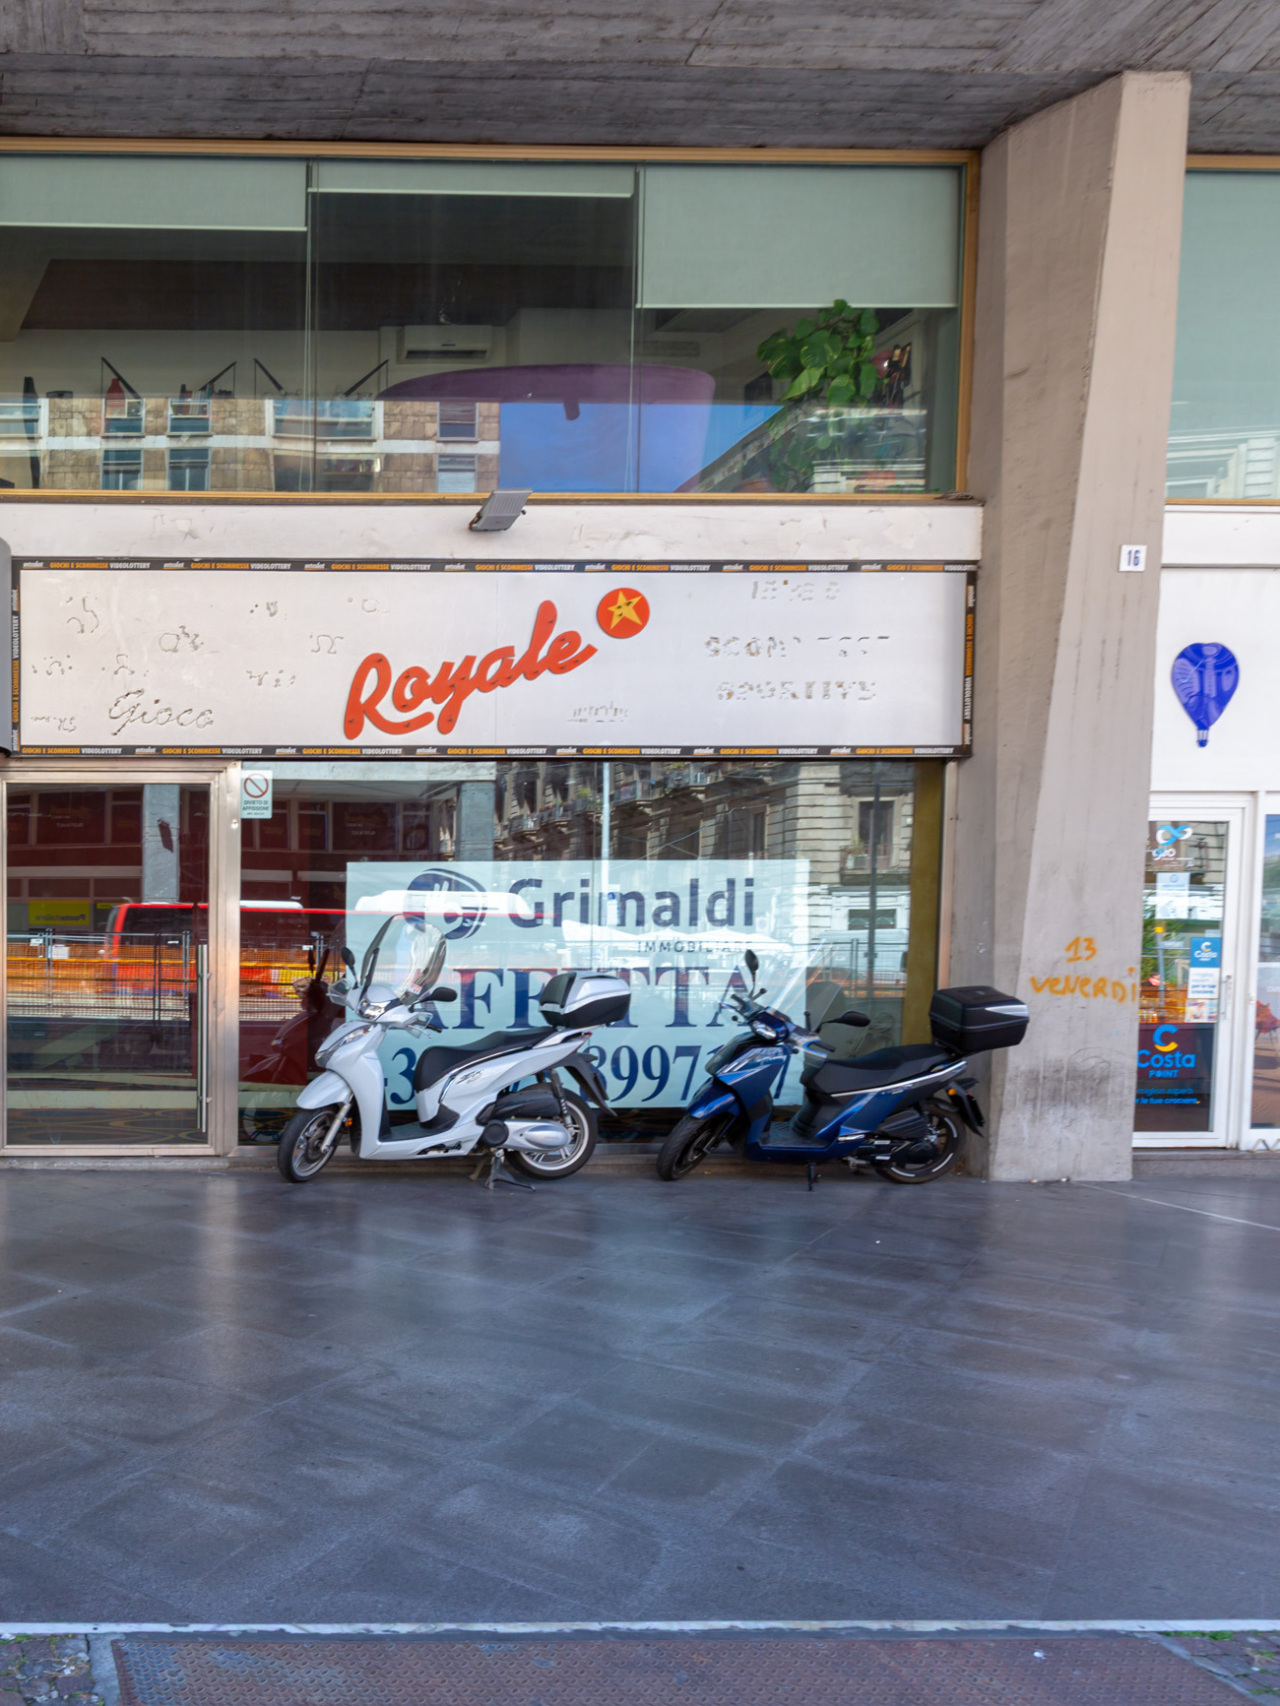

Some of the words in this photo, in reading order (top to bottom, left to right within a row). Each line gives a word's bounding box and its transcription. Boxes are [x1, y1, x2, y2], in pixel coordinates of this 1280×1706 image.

[1127, 550, 1140, 566] 16
[344, 600, 598, 739] Royale
[510, 878, 755, 928] Grimaldi
[1065, 936, 1098, 962] 13
[1137, 1049, 1196, 1068] Costa
